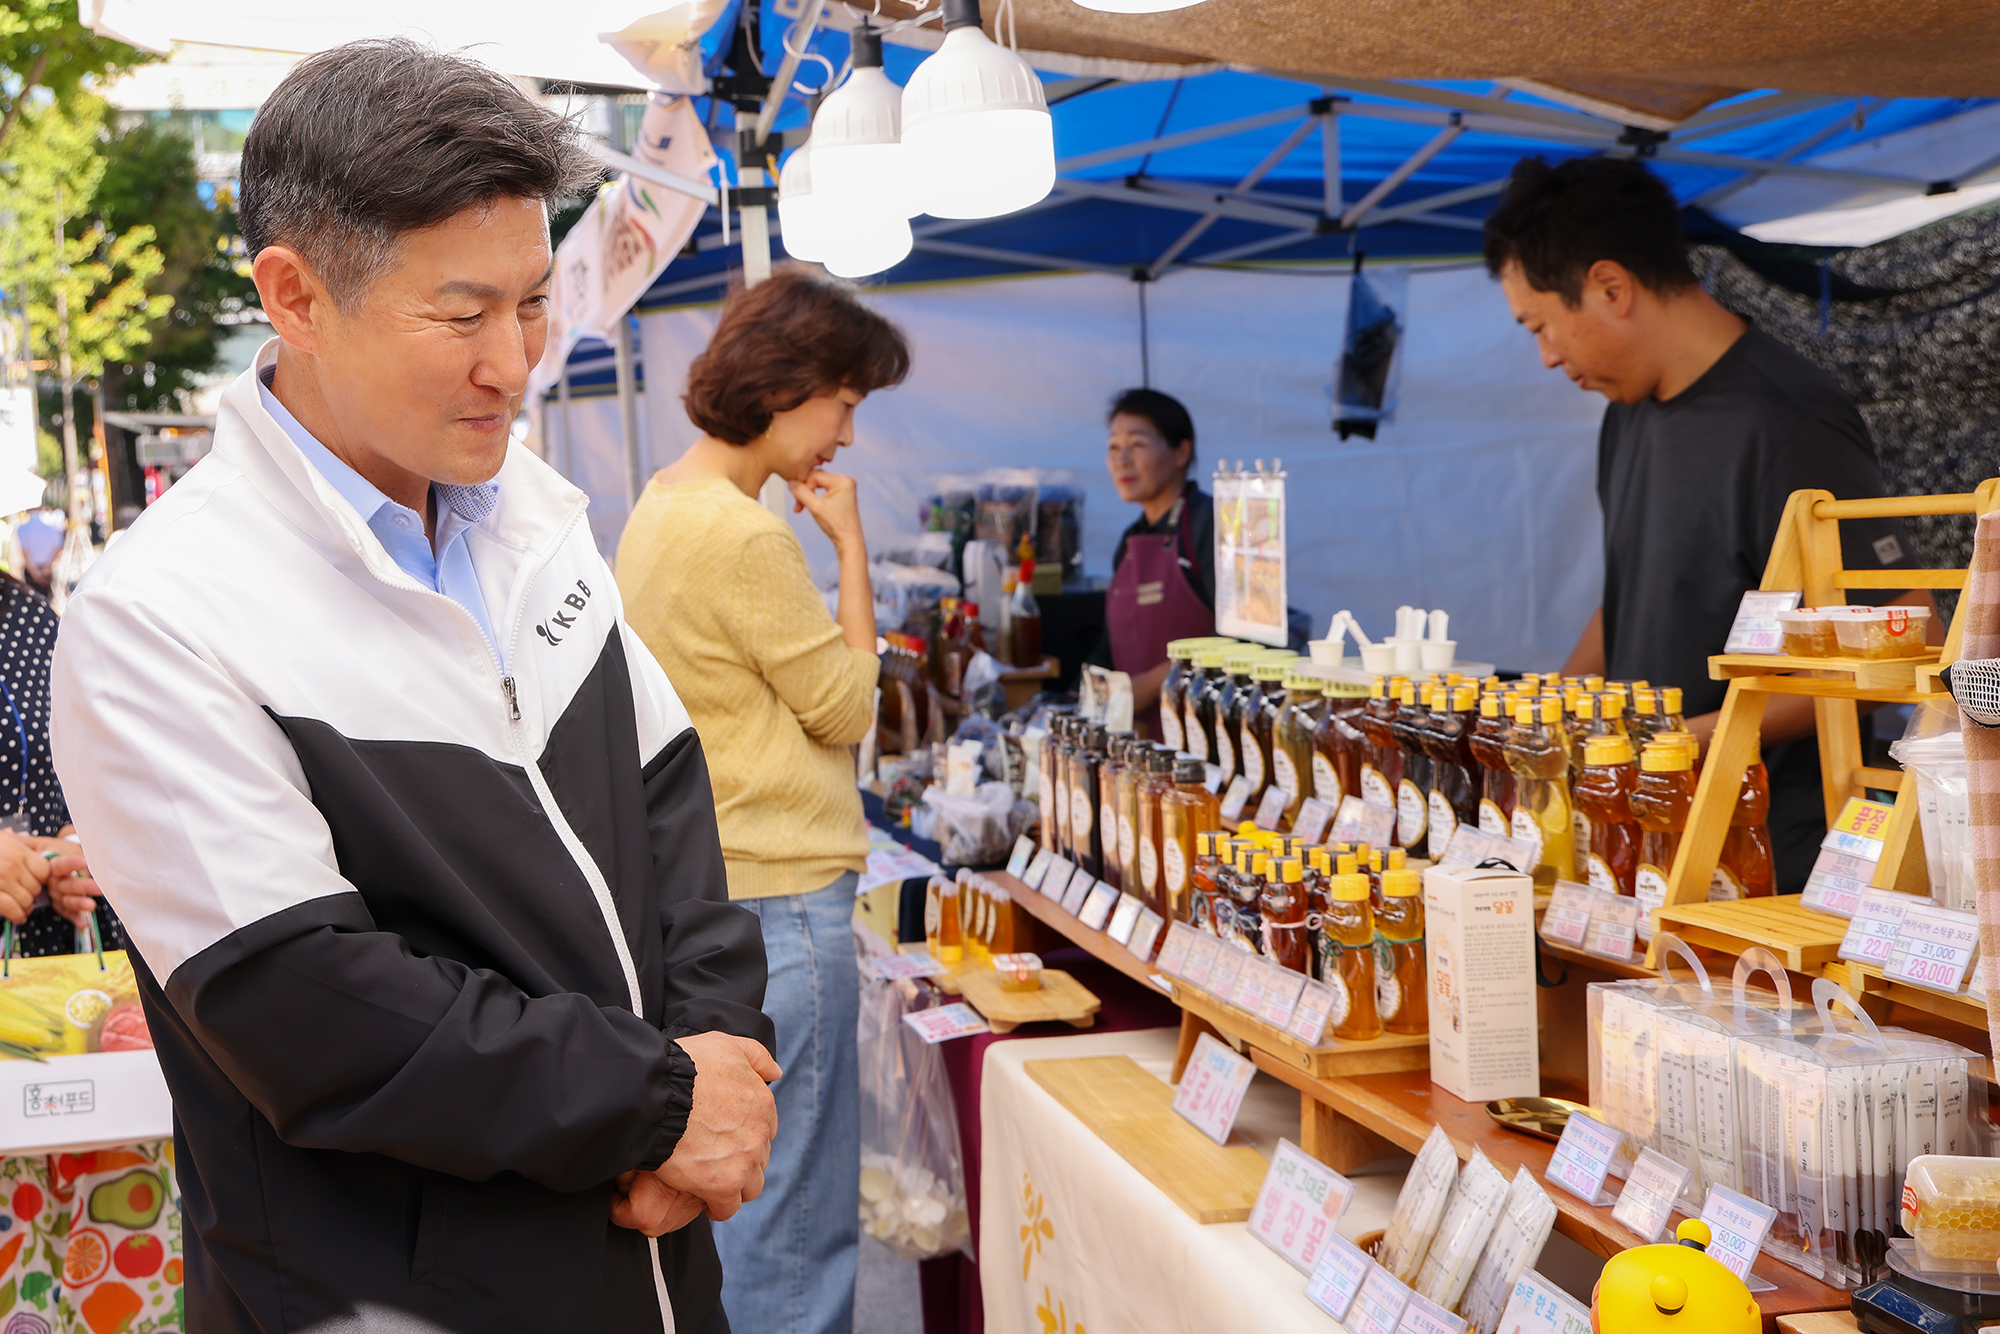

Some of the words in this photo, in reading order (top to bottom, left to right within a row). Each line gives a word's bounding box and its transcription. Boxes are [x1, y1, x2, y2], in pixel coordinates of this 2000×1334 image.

[551, 579, 591, 629] KBB
[1904, 918, 1932, 933] 아카시아
[1931, 924, 1955, 939] 스틱꿀
[1955, 931, 1974, 942] 30포
[1921, 943, 1956, 960] 31,000
[1907, 958, 1956, 986] 23,000
[28, 1084, 92, 1116] 홍천푸드
[1574, 1151, 1599, 1173] 50,000
[1274, 1156, 1298, 1188] 자연
[1294, 1167, 1329, 1205] 그대로
[1562, 1163, 1596, 1196] 35,000
[1261, 1186, 1328, 1264] 벌집꿀
[1716, 1205, 1724, 1217] 밤
[1722, 1208, 1740, 1225] 스틱꿀
[1738, 1216, 1753, 1230] 50포
[1718, 1229, 1747, 1253] 60,000
[1515, 1281, 1535, 1306] 하루
[1534, 1293, 1547, 1317] 한
[1545, 1301, 1559, 1328] 포,
